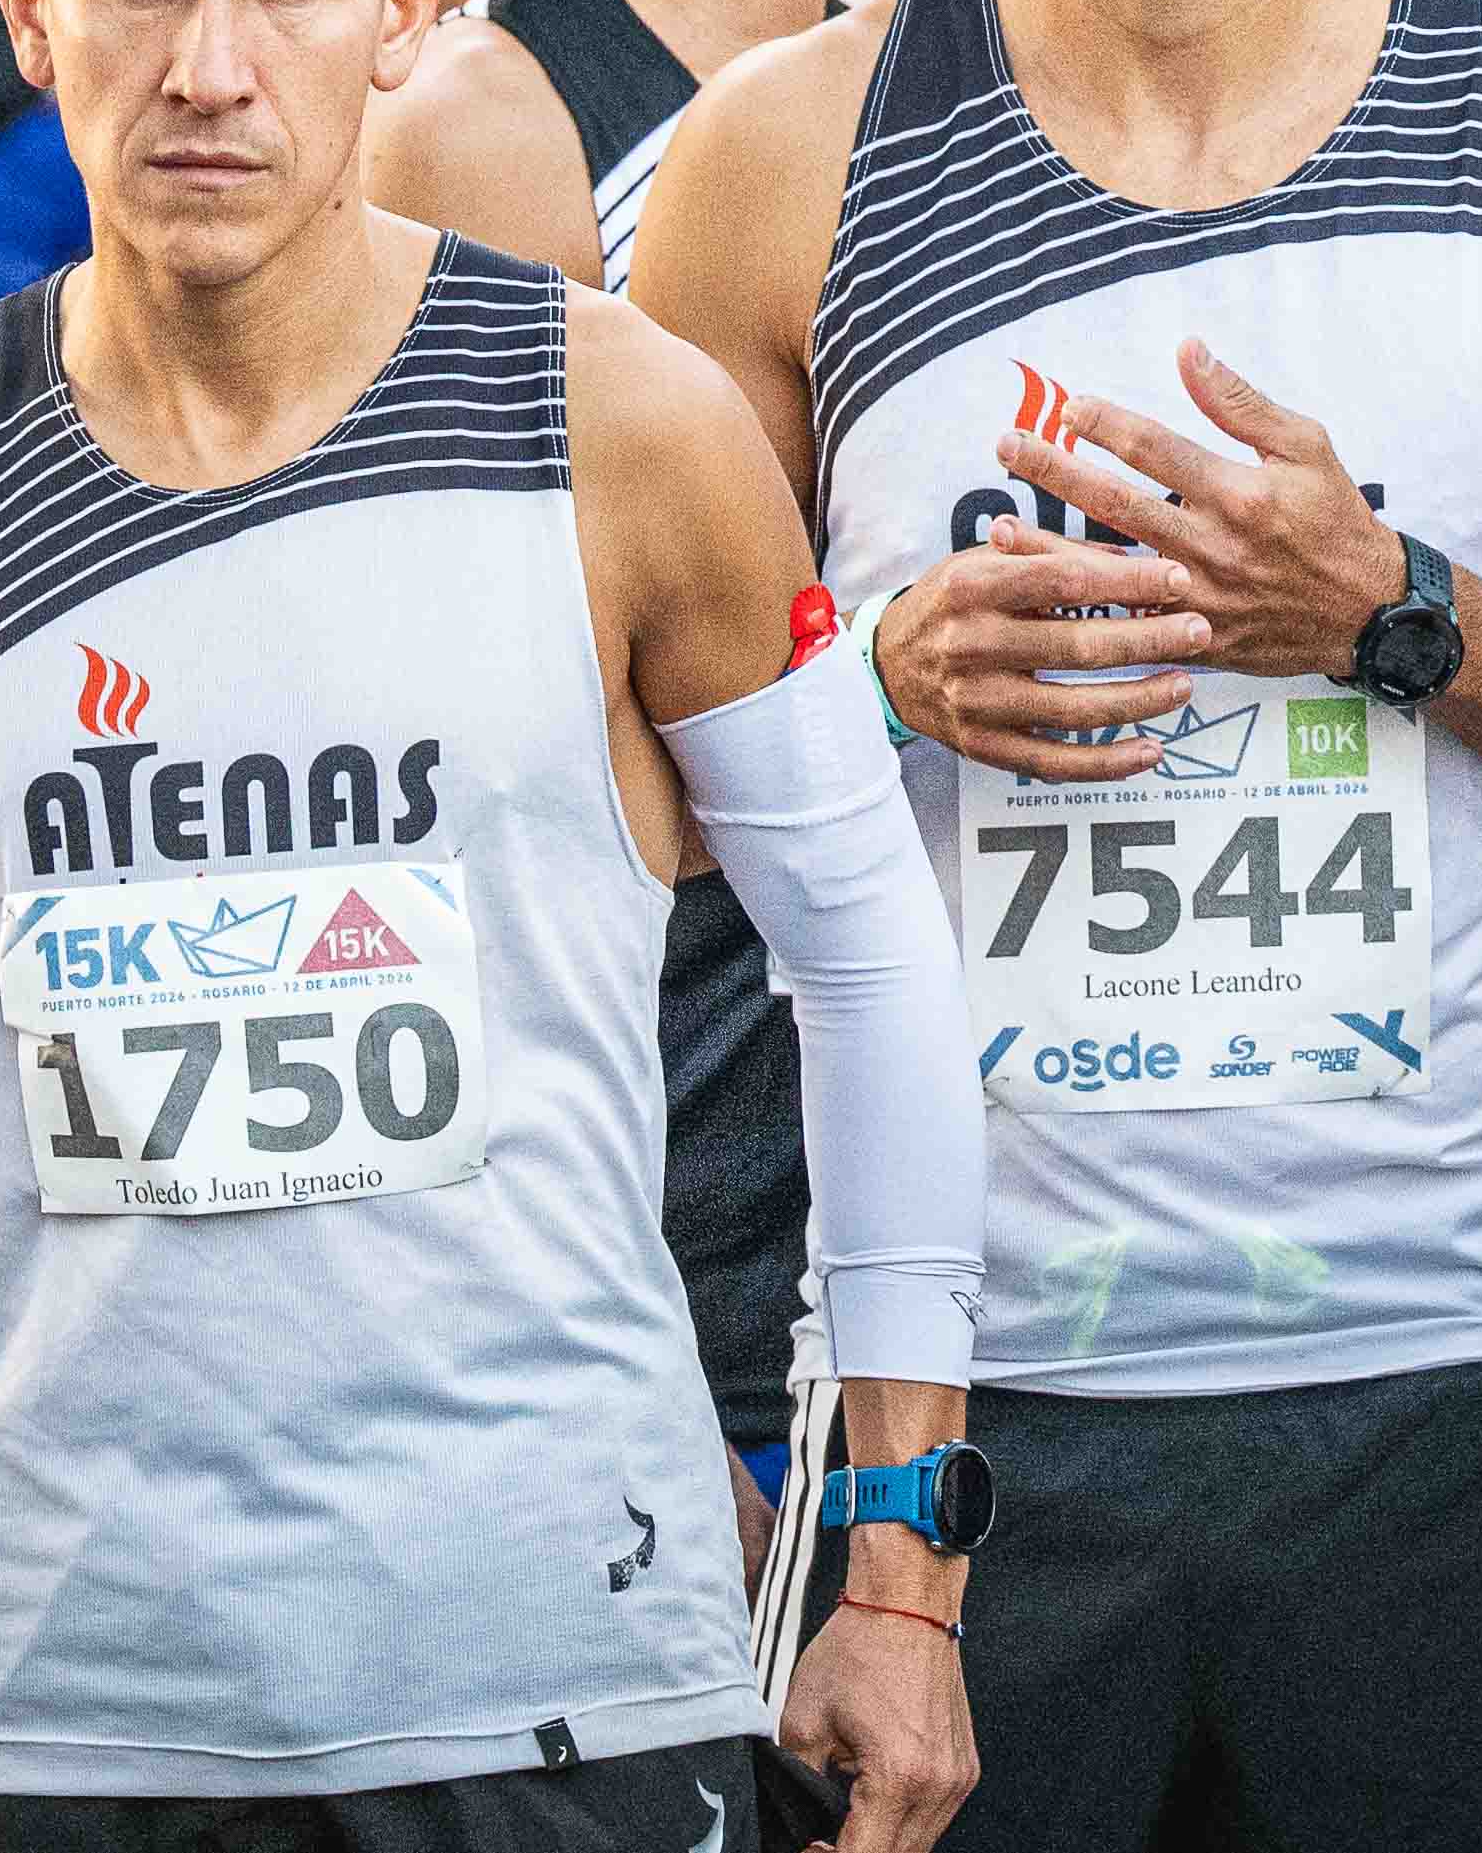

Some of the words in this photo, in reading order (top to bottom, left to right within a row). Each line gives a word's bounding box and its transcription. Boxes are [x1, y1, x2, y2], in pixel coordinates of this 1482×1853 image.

[1296, 720, 1360, 756] 10K
[23, 739, 441, 876] ATENAS
[1064, 790, 1110, 805] NORTE
[1115, 788, 1148, 803] 2026
[1164, 785, 1226, 801] ROSARIO
[1243, 784, 1257, 798] 12
[1264, 783, 1282, 797] DE
[1287, 781, 1328, 797] ABRIL
[977, 812, 1413, 959] 7544
[35, 923, 162, 992] 15K
[322, 928, 390, 962] 15K
[97, 994, 144, 1009] NORTE
[202, 984, 267, 1001] ROSARIO
[283, 981, 299, 995] 12
[305, 979, 324, 993] DE
[1084, 973, 1182, 1000] Lacone
[1191, 968, 1303, 996] Leandro
[1292, 1047, 1361, 1063] POWER
[36, 1002, 461, 1161] 1750
[115, 1178, 198, 1206] Toledo
[208, 1175, 270, 1203] Juan
[280, 1164, 384, 1204] Ignacio
